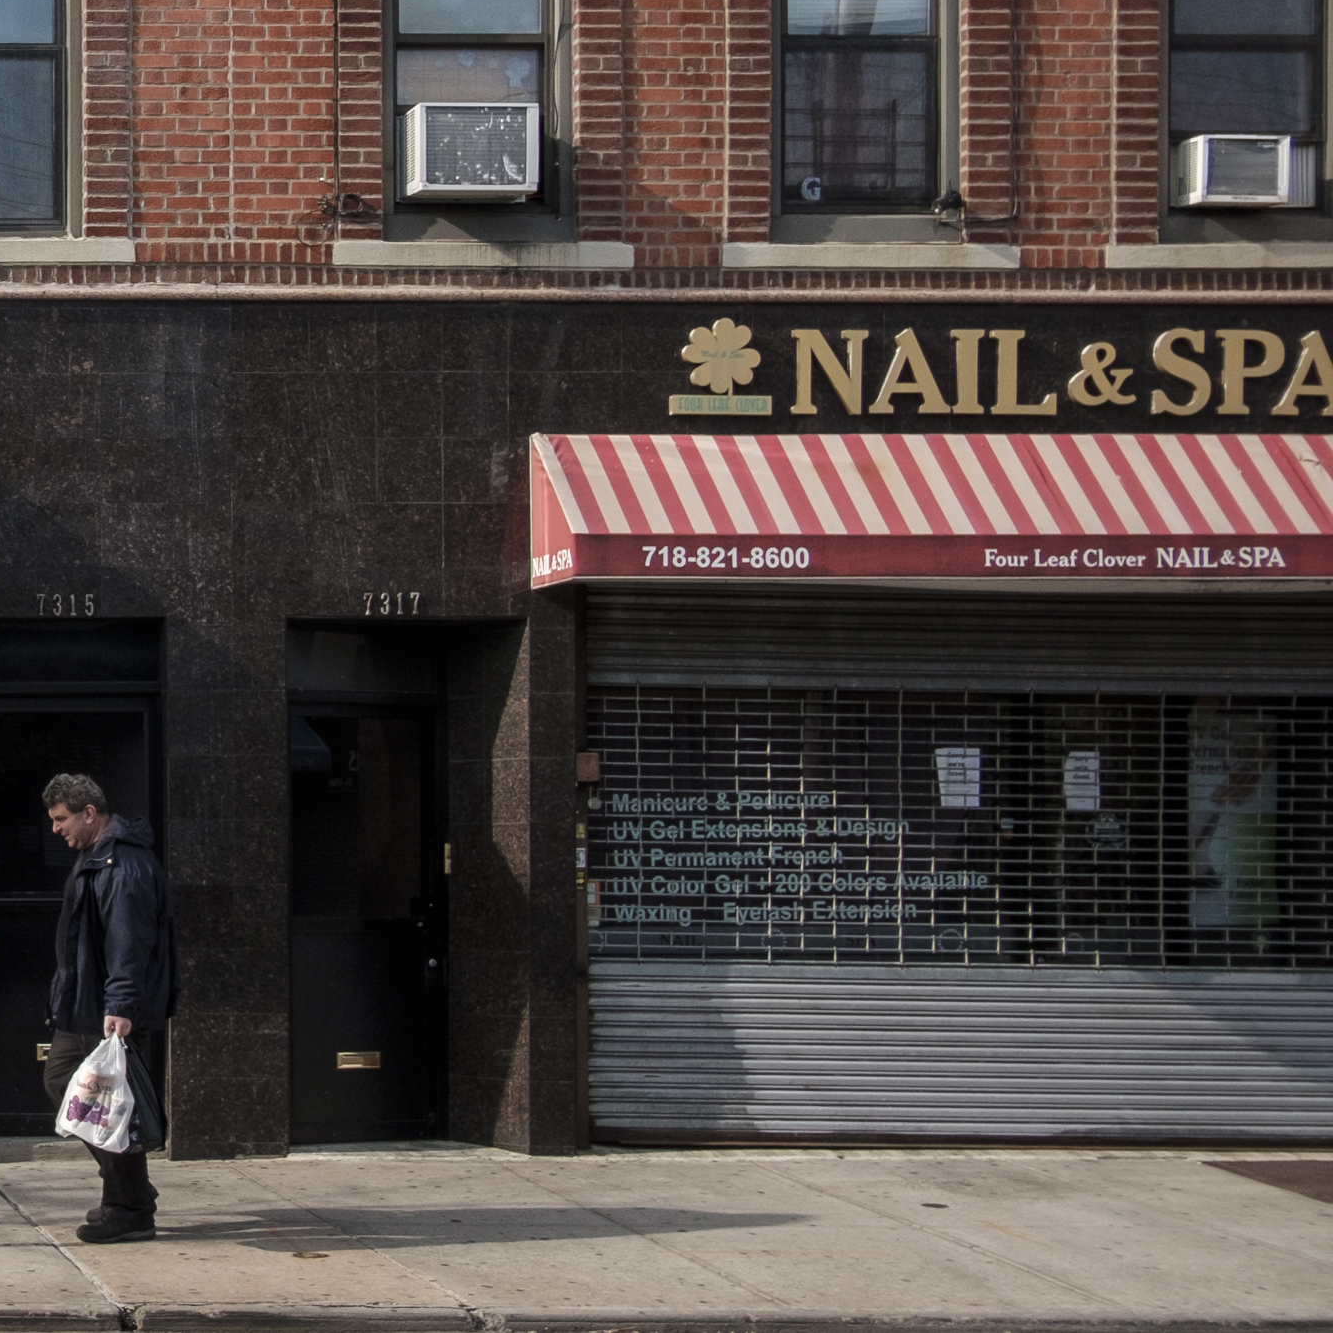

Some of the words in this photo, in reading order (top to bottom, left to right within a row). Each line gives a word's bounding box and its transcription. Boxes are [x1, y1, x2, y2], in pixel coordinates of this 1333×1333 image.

[790, 328, 1058, 416] NAIL
[1067, 340, 1137, 406] &
[1150, 327, 1333, 417] SPA
[532, 554, 552, 578] NAIL
[556, 547, 574, 571] SPA
[642, 545, 811, 569] 718-821-8600
[984, 548, 1029, 568] Four
[1034, 548, 1079, 568] Leaf
[1082, 548, 1147, 568] Clover
[1156, 547, 1218, 568] NAIL
[1238, 547, 1287, 568] SPA
[35, 594, 96, 617] 7315
[362, 591, 421, 616] 7317
[611, 792, 708, 814] Manicure
[715, 791, 731, 811] &
[737, 790, 831, 811] Pedicure
[612, 822, 644, 841] UV
[649, 820, 685, 840] Gel
[690, 818, 808, 839] Extensions
[815, 817, 830, 835] &
[836, 817, 911, 840] Design
[613, 849, 644, 868] UV
[649, 847, 765, 868] Permanent
[770, 845, 844, 866] French
[612, 878, 644, 896] UV
[650, 876, 706, 895] Color
[715, 874, 750, 894] Gel
[774, 874, 811, 894] 200
[817, 873, 887, 893] Colors
[892, 871, 989, 891] Available
[613, 903, 692, 927] Waxing
[723, 901, 804, 926] Eyelash
[811, 900, 918, 921] Extension
